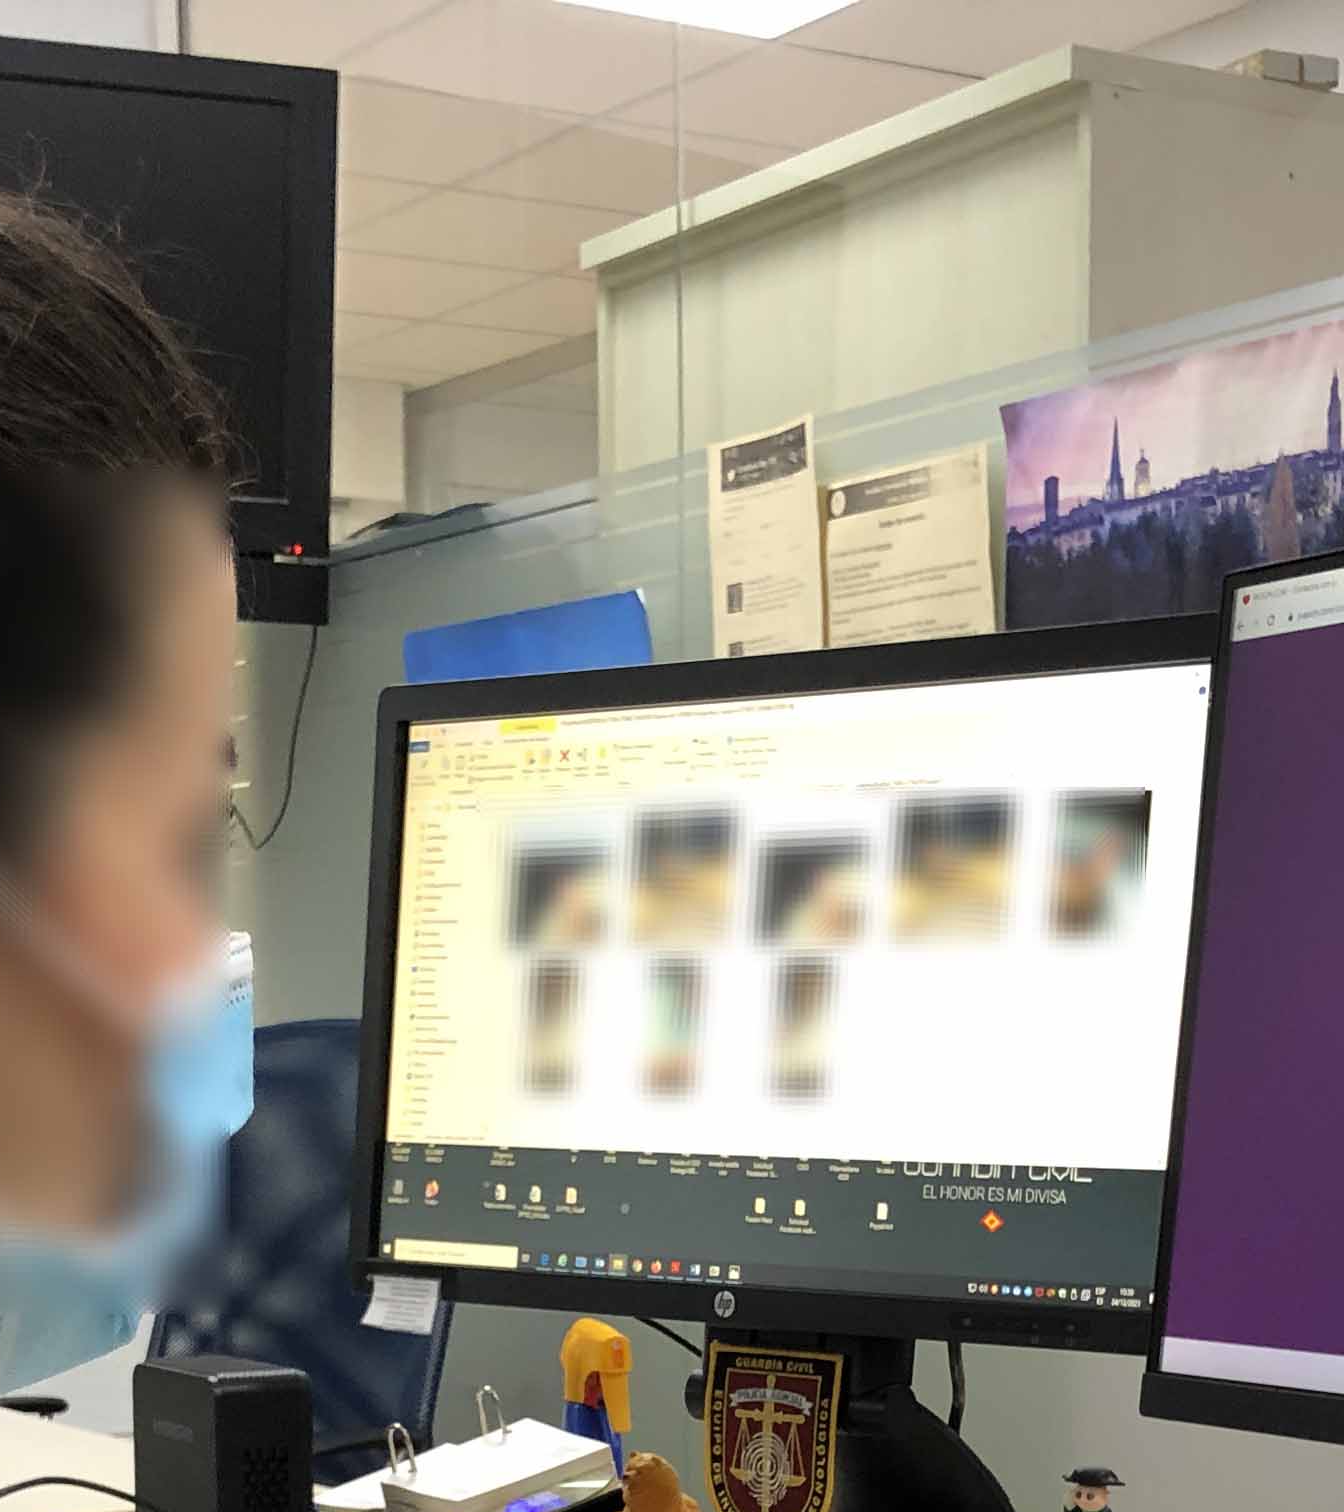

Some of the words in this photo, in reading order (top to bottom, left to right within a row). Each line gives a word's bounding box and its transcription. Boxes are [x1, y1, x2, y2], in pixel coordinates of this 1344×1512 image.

[923, 1184, 937, 1200] EL
[940, 1185, 985, 1202] HONOR
[988, 1187, 1005, 1202] ES
[1007, 1188, 1022, 1202] MI
[1025, 1188, 1067, 1204] DIVISA
[736, 1357, 784, 1370] GUARDIA
[712, 1389, 724, 1456] EQUIPO
[712, 1461, 724, 1483] DE
